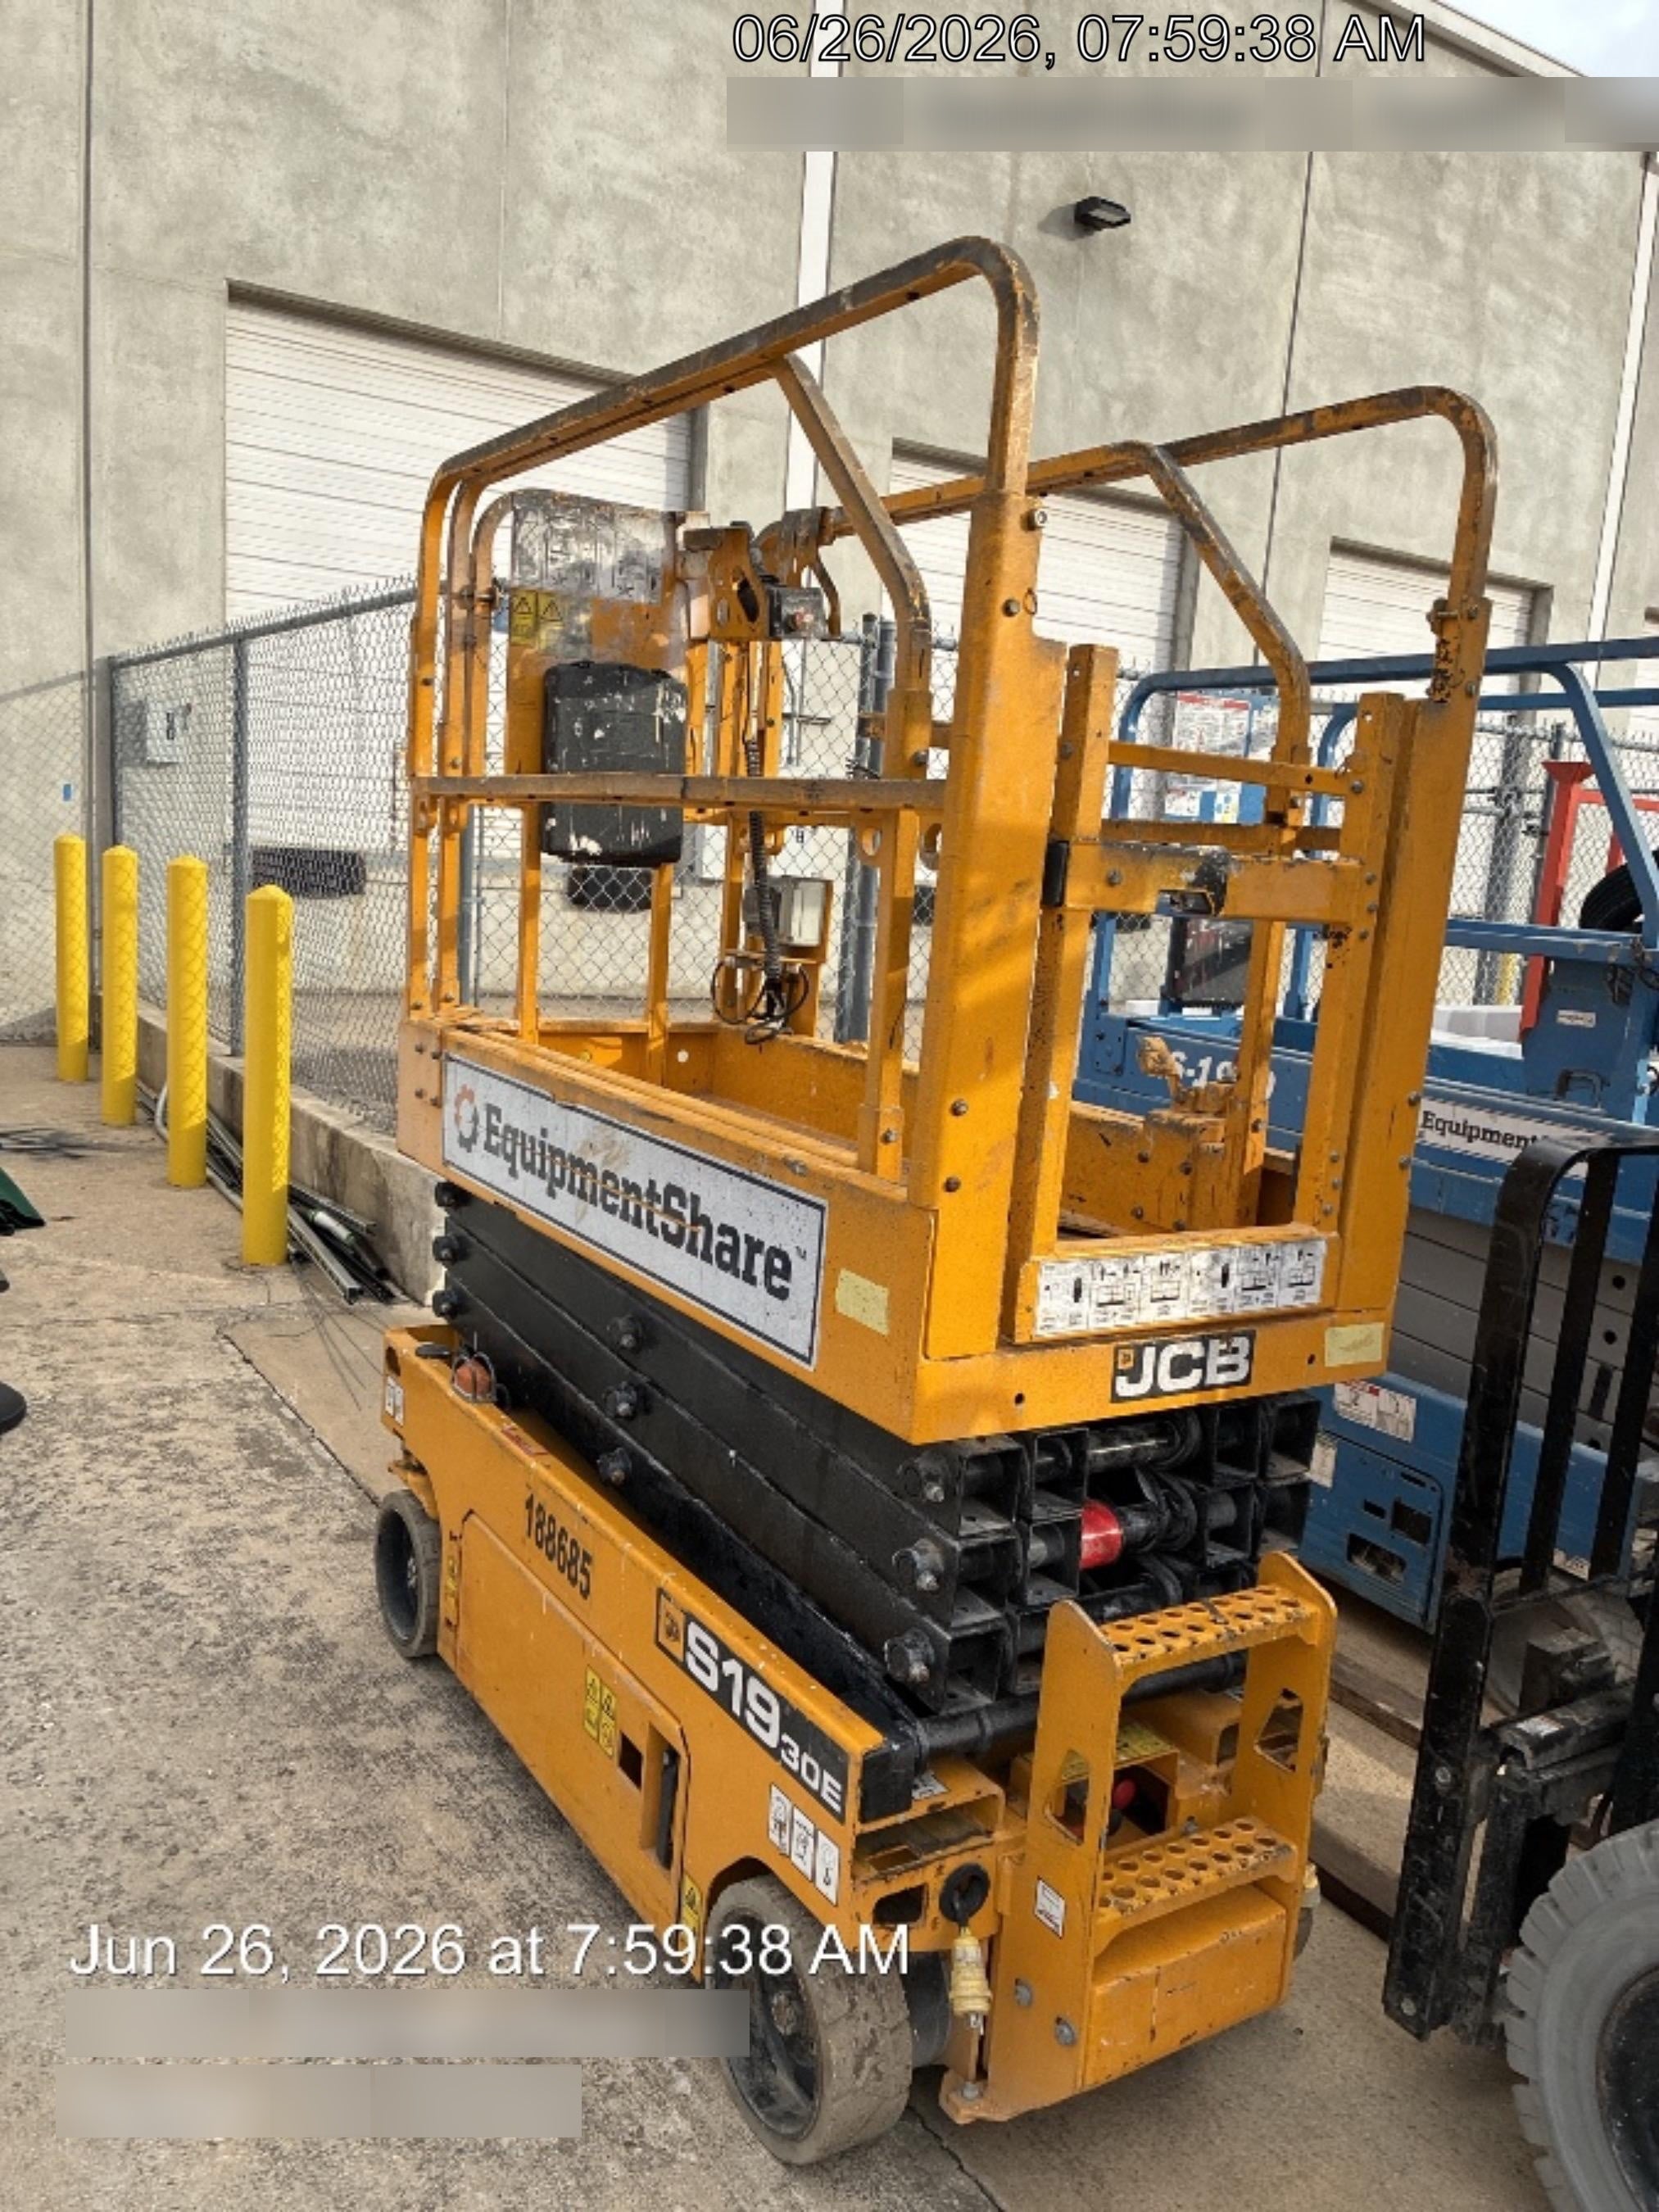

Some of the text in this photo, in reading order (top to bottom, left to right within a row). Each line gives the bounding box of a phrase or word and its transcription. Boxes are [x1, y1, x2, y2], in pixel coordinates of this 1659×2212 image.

[1421, 1110, 1549, 1148] Equipment
[484, 1103, 792, 1302] EquipmentShare
[1115, 1336, 1250, 1397] JCB
[525, 1493, 592, 1601] 188685
